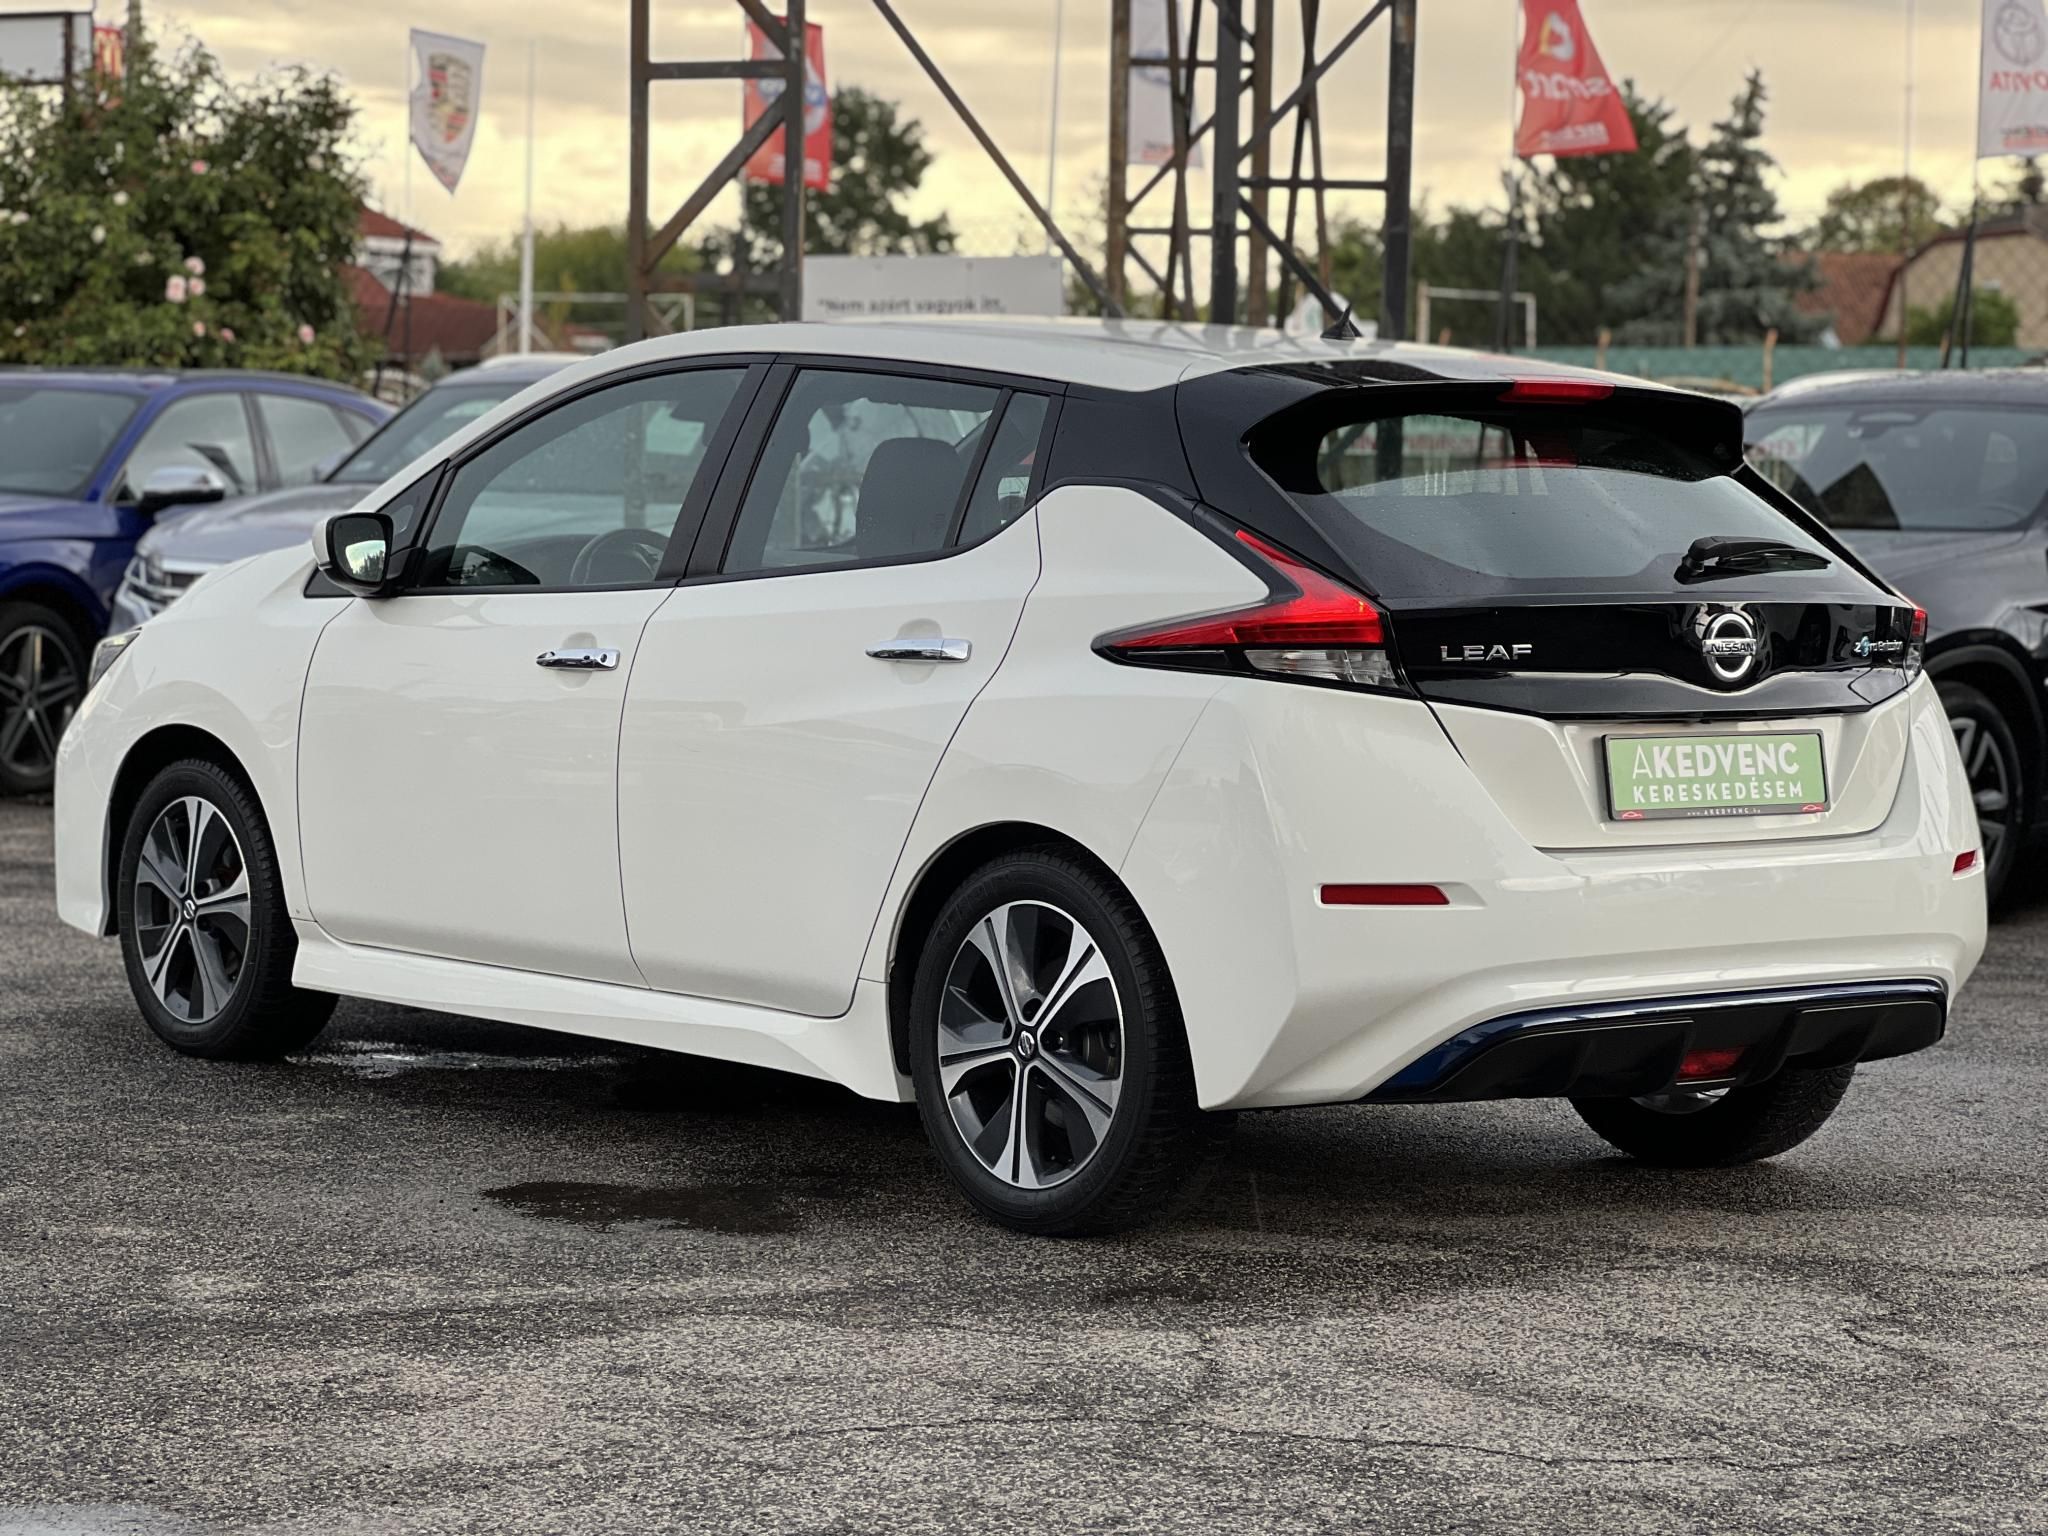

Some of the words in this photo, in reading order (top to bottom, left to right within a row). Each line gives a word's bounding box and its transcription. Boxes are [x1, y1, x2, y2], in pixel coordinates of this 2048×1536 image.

[1440, 644, 1532, 661] LEAF
[1711, 642, 1754, 653] NISSAN
[1632, 742, 1800, 779] AKEDVENC
[1633, 777, 1803, 803] KERESKEDÉSEM
